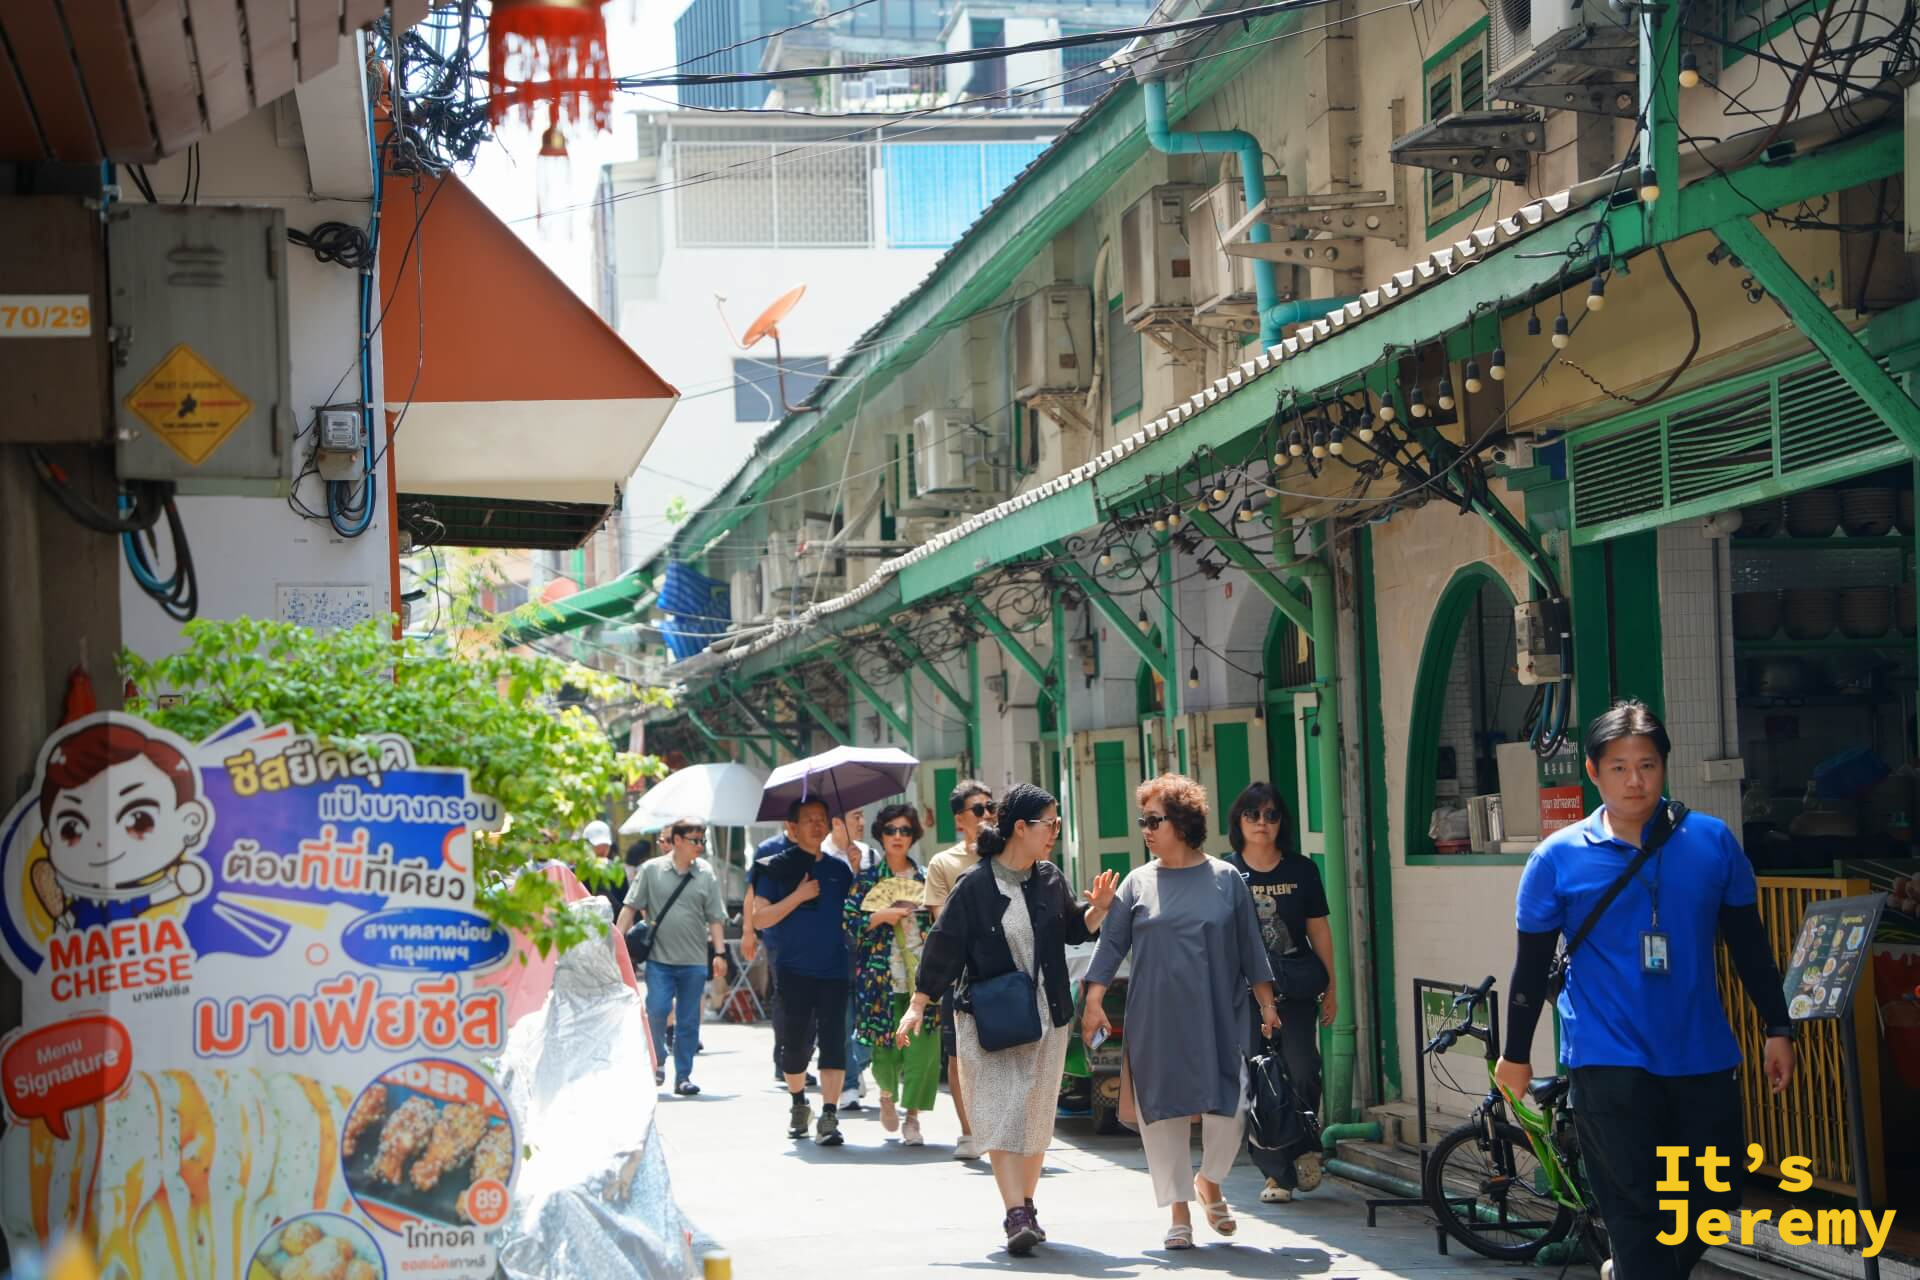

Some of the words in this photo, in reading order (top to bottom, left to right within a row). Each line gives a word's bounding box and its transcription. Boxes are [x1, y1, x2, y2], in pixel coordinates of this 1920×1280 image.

[1, 304, 90, 329] 70/29
[321, 788, 498, 822] แป้งบางกรอบ
[226, 828, 466, 901] ต้องที่นี่ที่เดียว
[50, 919, 183, 971] MAFIA
[363, 920, 492, 942] สาขาตลาดน้อย
[390, 944, 469, 967] กรุงเทพฯ
[51, 953, 192, 1003] CHEESE
[198, 976, 499, 1053] มาเฟียชีส
[36, 1038, 82, 1065] Menu
[14, 1049, 119, 1098] Signature
[476, 1189, 502, 1208] 89
[405, 1225, 474, 1248] ไก่ทอด
